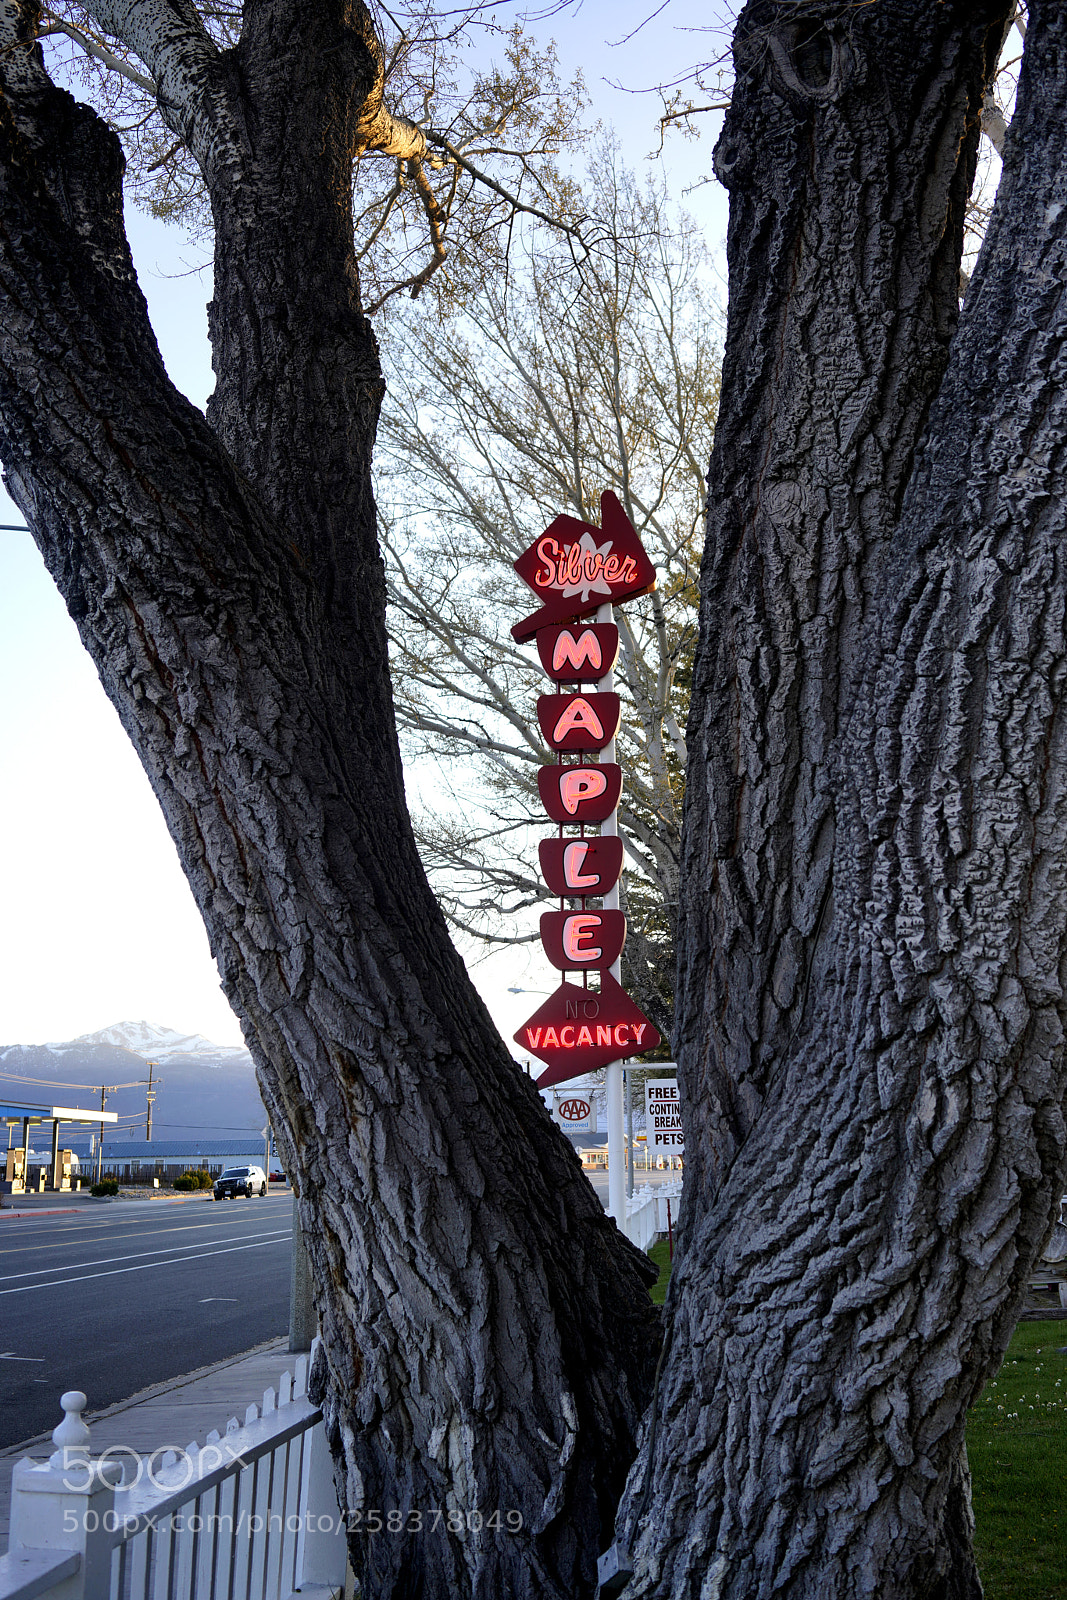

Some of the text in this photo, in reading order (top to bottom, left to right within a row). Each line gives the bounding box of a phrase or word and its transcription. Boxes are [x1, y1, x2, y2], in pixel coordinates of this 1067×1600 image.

[535, 537, 638, 588] Silver
[566, 999, 600, 1019] NO
[526, 1023, 646, 1048] VACANCY
[648, 1087, 677, 1099] FREE
[561, 1100, 588, 1120] AAA
[649, 1103, 680, 1115] CONTIN
[654, 1116, 682, 1128] BREAK
[655, 1133, 684, 1145] PETS
